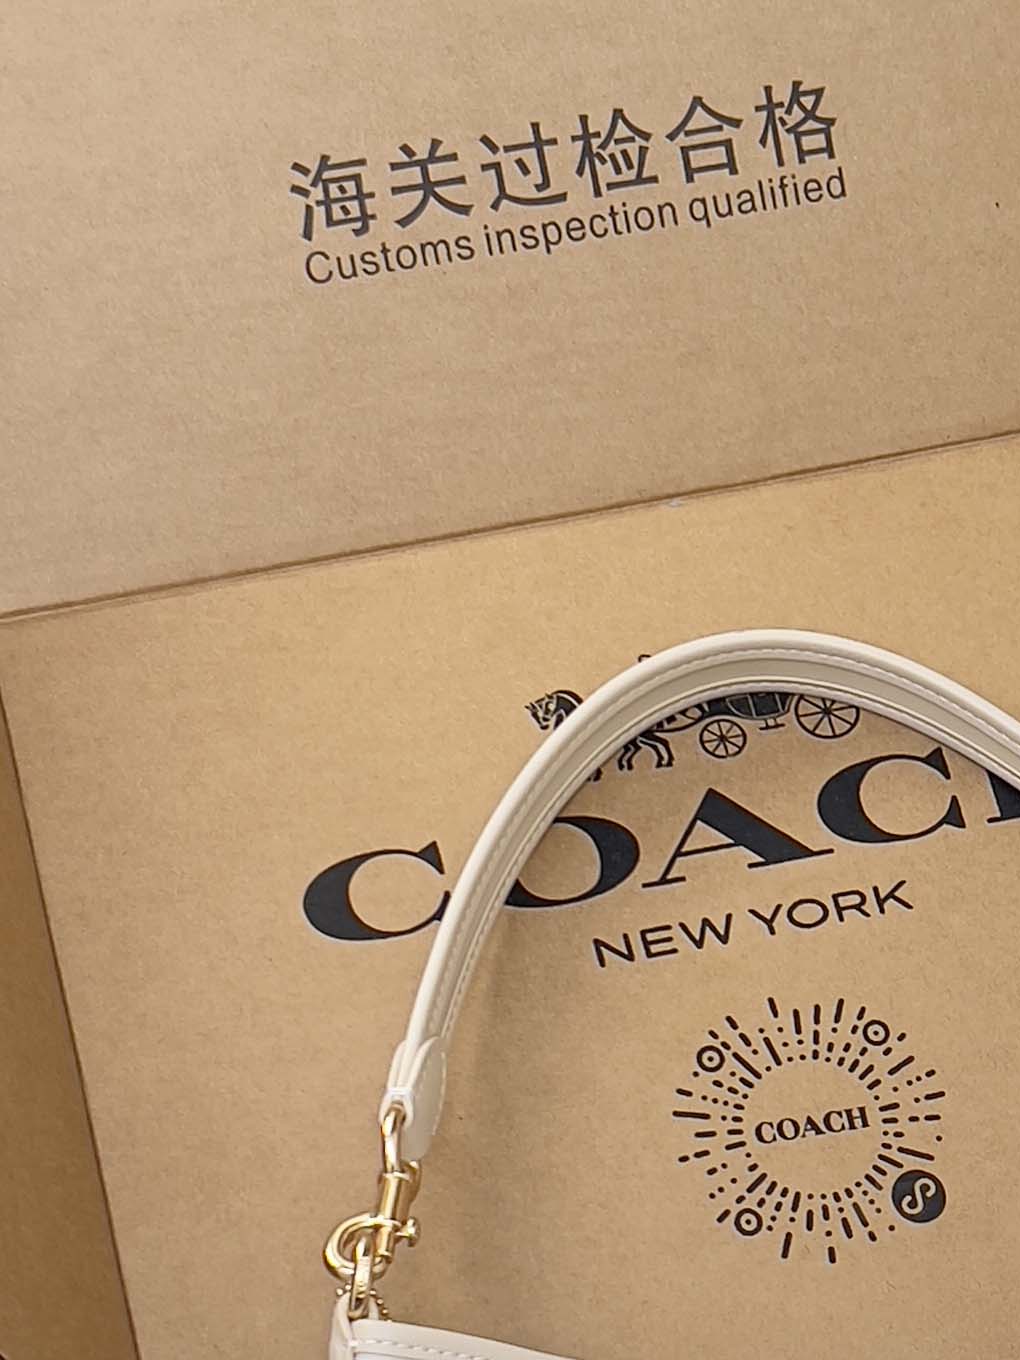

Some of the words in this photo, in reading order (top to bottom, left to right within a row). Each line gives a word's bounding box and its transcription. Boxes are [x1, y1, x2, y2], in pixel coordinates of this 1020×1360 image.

[290, 80, 839, 241] 海关过检合格
[304, 230, 475, 285] Customs
[483, 197, 679, 265] inspection
[688, 167, 848, 229] qualified
[593, 913, 734, 968] NEW
[749, 880, 914, 937] YORK
[755, 1106, 870, 1143] COACH
